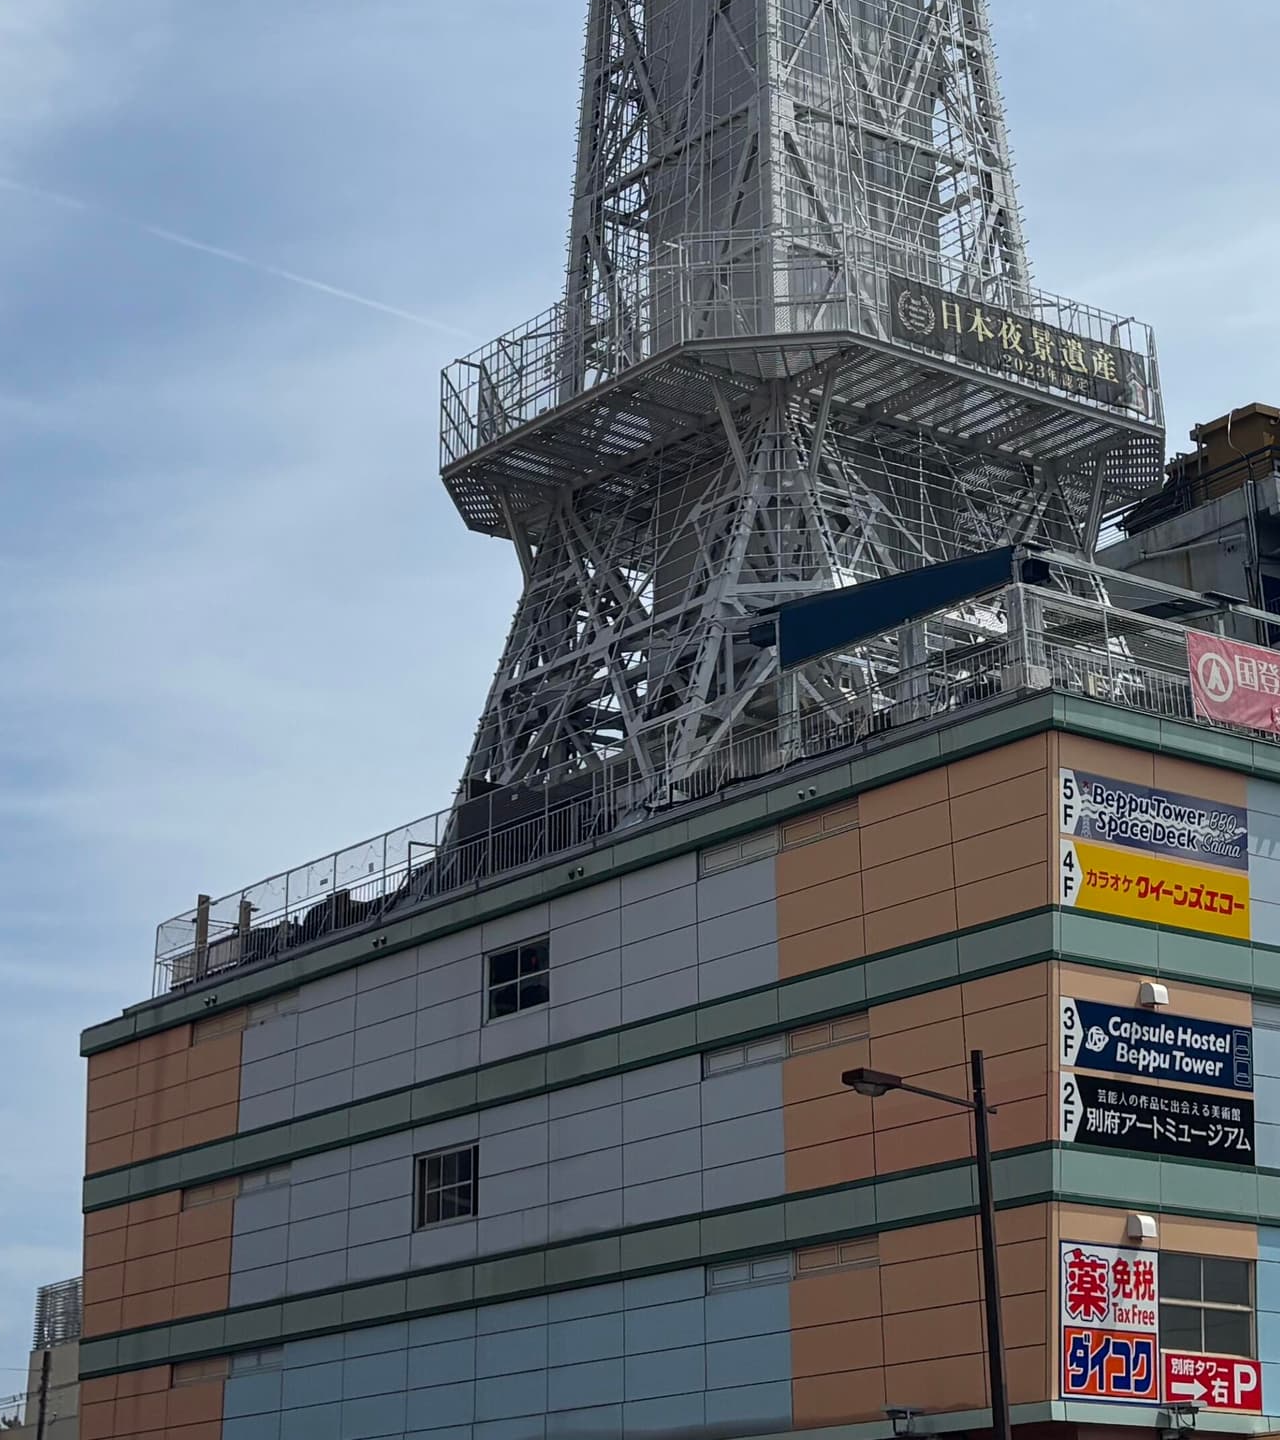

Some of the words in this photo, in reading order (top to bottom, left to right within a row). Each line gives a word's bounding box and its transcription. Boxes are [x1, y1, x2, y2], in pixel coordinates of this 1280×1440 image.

[941, 299, 1119, 383] 日本夜景遺産
[1092, 783, 1150, 815] Beppu
[1152, 797, 1205, 827] Tower
[1209, 811, 1237, 837] BBQ
[1096, 810, 1151, 842] Space
[1152, 822, 1197, 851] Deck
[1201, 834, 1242, 859] Sauna
[1086, 868, 1133, 893] カラオケ
[1135, 876, 1245, 915] クイーンズエコー
[1108, 1016, 1175, 1045] Capsule
[1177, 1027, 1230, 1054] Hostel
[1116, 1042, 1170, 1073] Beppu
[1172, 1051, 1223, 1077] Tower
[1097, 1089, 1241, 1122] 芸能人の作品に出会える美術館
[1086, 1107, 1252, 1151] 別府アートミュージアム
[1066, 1248, 1108, 1320] 薬
[1111, 1257, 1155, 1302] 免税
[1112, 1303, 1131, 1325] Tax
[1132, 1304, 1155, 1326] Free
[1068, 1332, 1153, 1394] ダイコク
[1171, 1358, 1228, 1376] 別府タワー
[1234, 1364, 1257, 1404] P
[1211, 1377, 1229, 1404] 右
